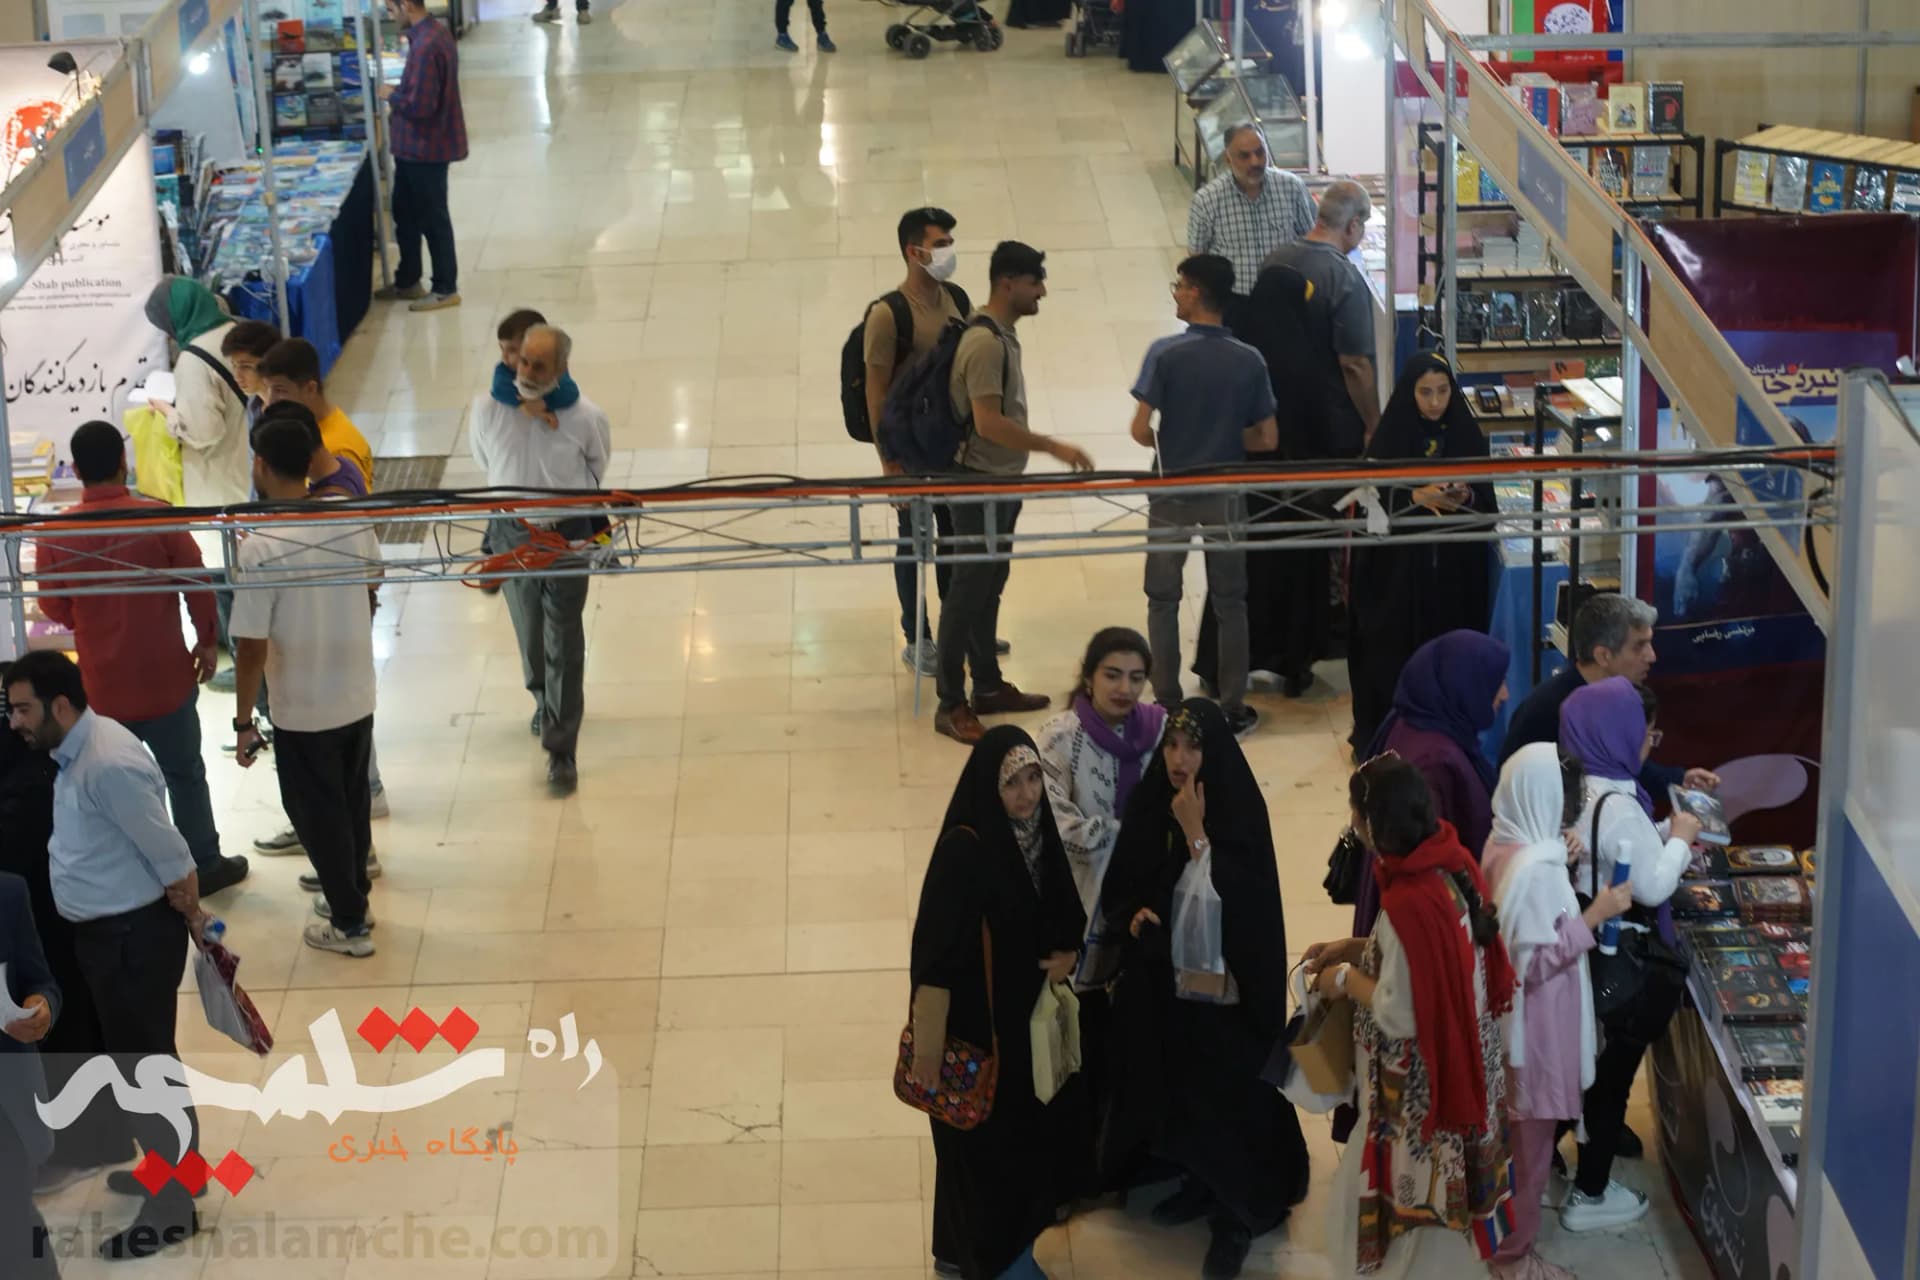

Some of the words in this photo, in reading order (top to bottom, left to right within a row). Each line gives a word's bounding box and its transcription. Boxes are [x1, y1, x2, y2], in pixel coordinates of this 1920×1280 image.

[32, 279, 58, 290] Shab
[62, 277, 122, 290] publication
[1796, 367, 1839, 395] نبرد
